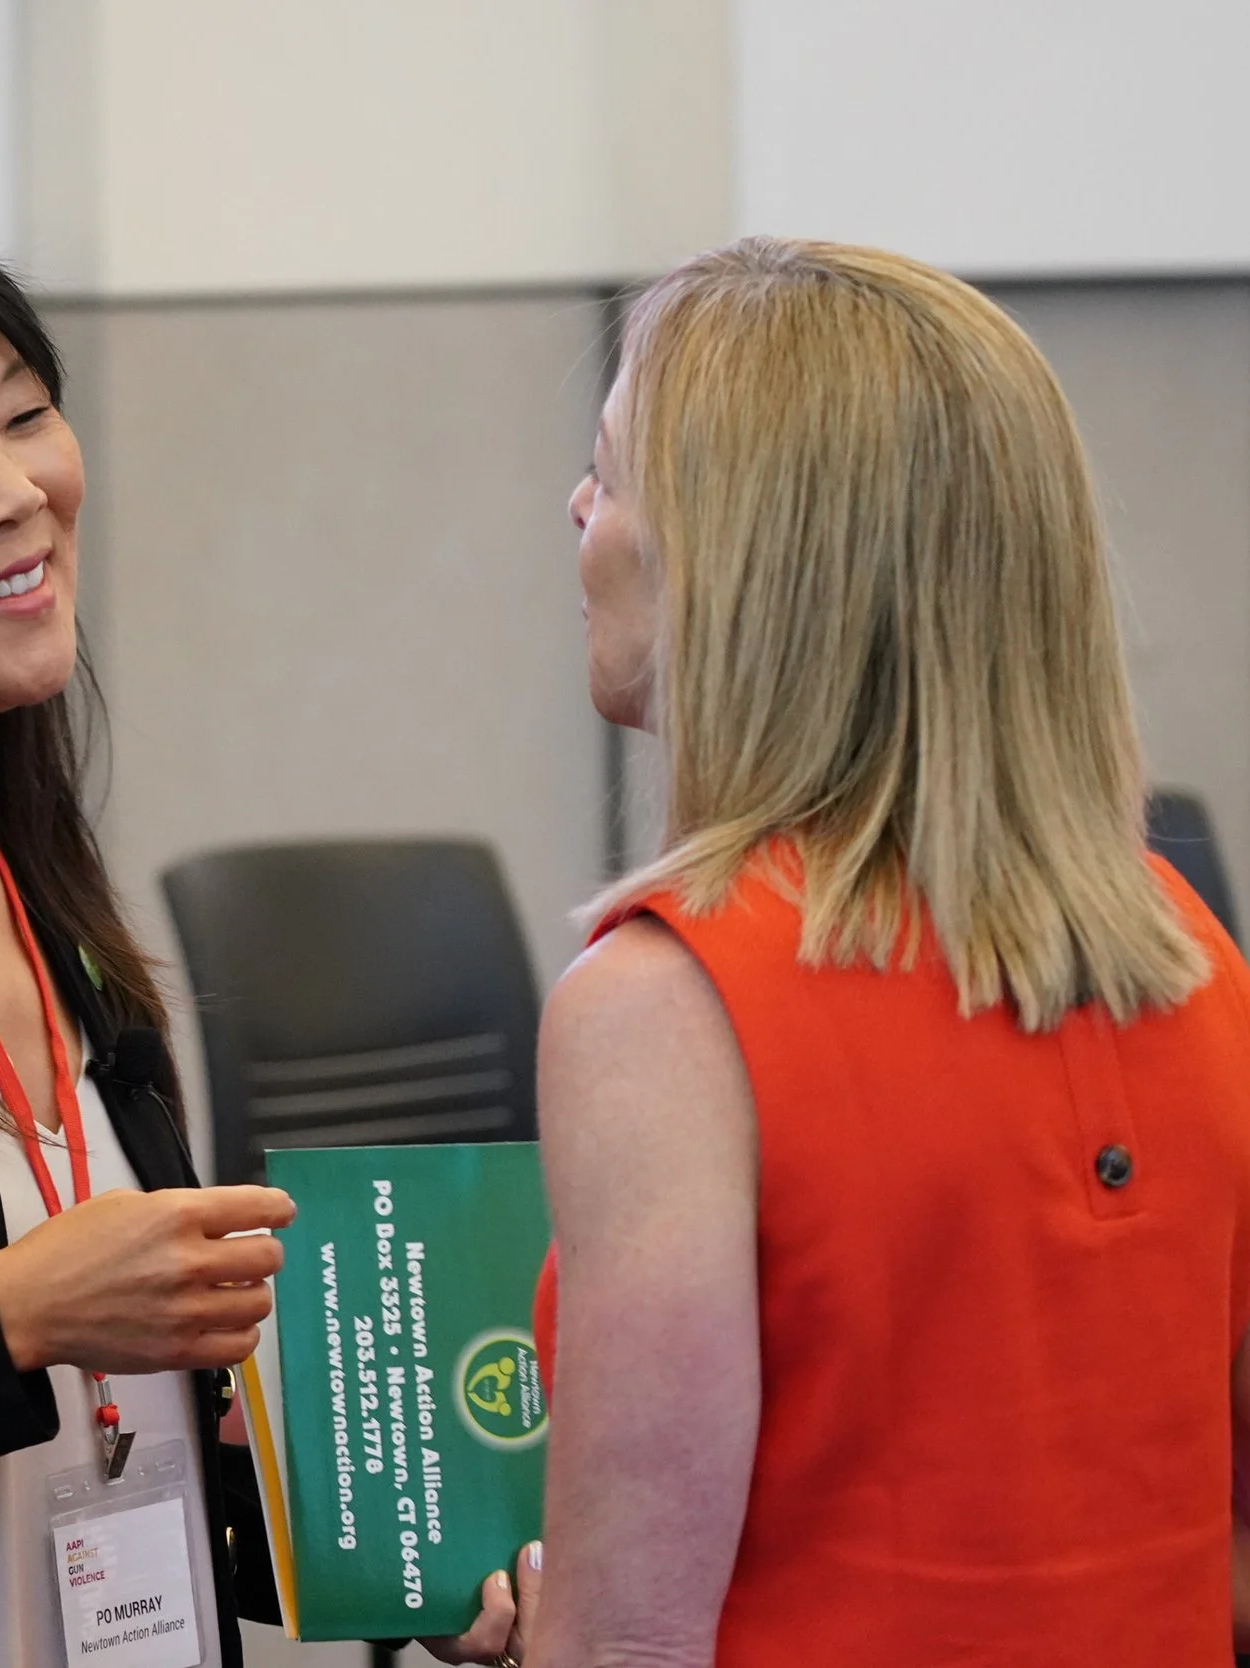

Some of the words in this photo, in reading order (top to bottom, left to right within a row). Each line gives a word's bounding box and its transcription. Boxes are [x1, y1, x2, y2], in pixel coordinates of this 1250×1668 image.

[372, 1179, 393, 1217] PO
[375, 1222, 395, 1271] Box
[379, 1276, 402, 1336] 3325
[404, 1241, 427, 1358] Newtown
[517, 1346, 529, 1382] Action
[320, 1242, 357, 1551] www.newtownaction.org
[353, 1315, 384, 1475] 203.512.1778
[414, 1364, 436, 1441] Action
[519, 1383, 532, 1429] Alliance
[385, 1366, 409, 1491] Newtown,
[397, 1496, 417, 1525] CT
[421, 1447, 443, 1545] Alliance
[66, 1539, 84, 1551] AAPI
[67, 1547, 99, 1563] AGAINST
[68, 1563, 85, 1576] GUN
[69, 1570, 106, 1588] VIOLENCE
[399, 1530, 424, 1609] 06470
[96, 1607, 112, 1626] PO
[114, 1595, 163, 1621] MURRAY
[81, 1632, 121, 1655] Newtown
[122, 1625, 150, 1644] Action
[151, 1617, 185, 1636] Alliance
